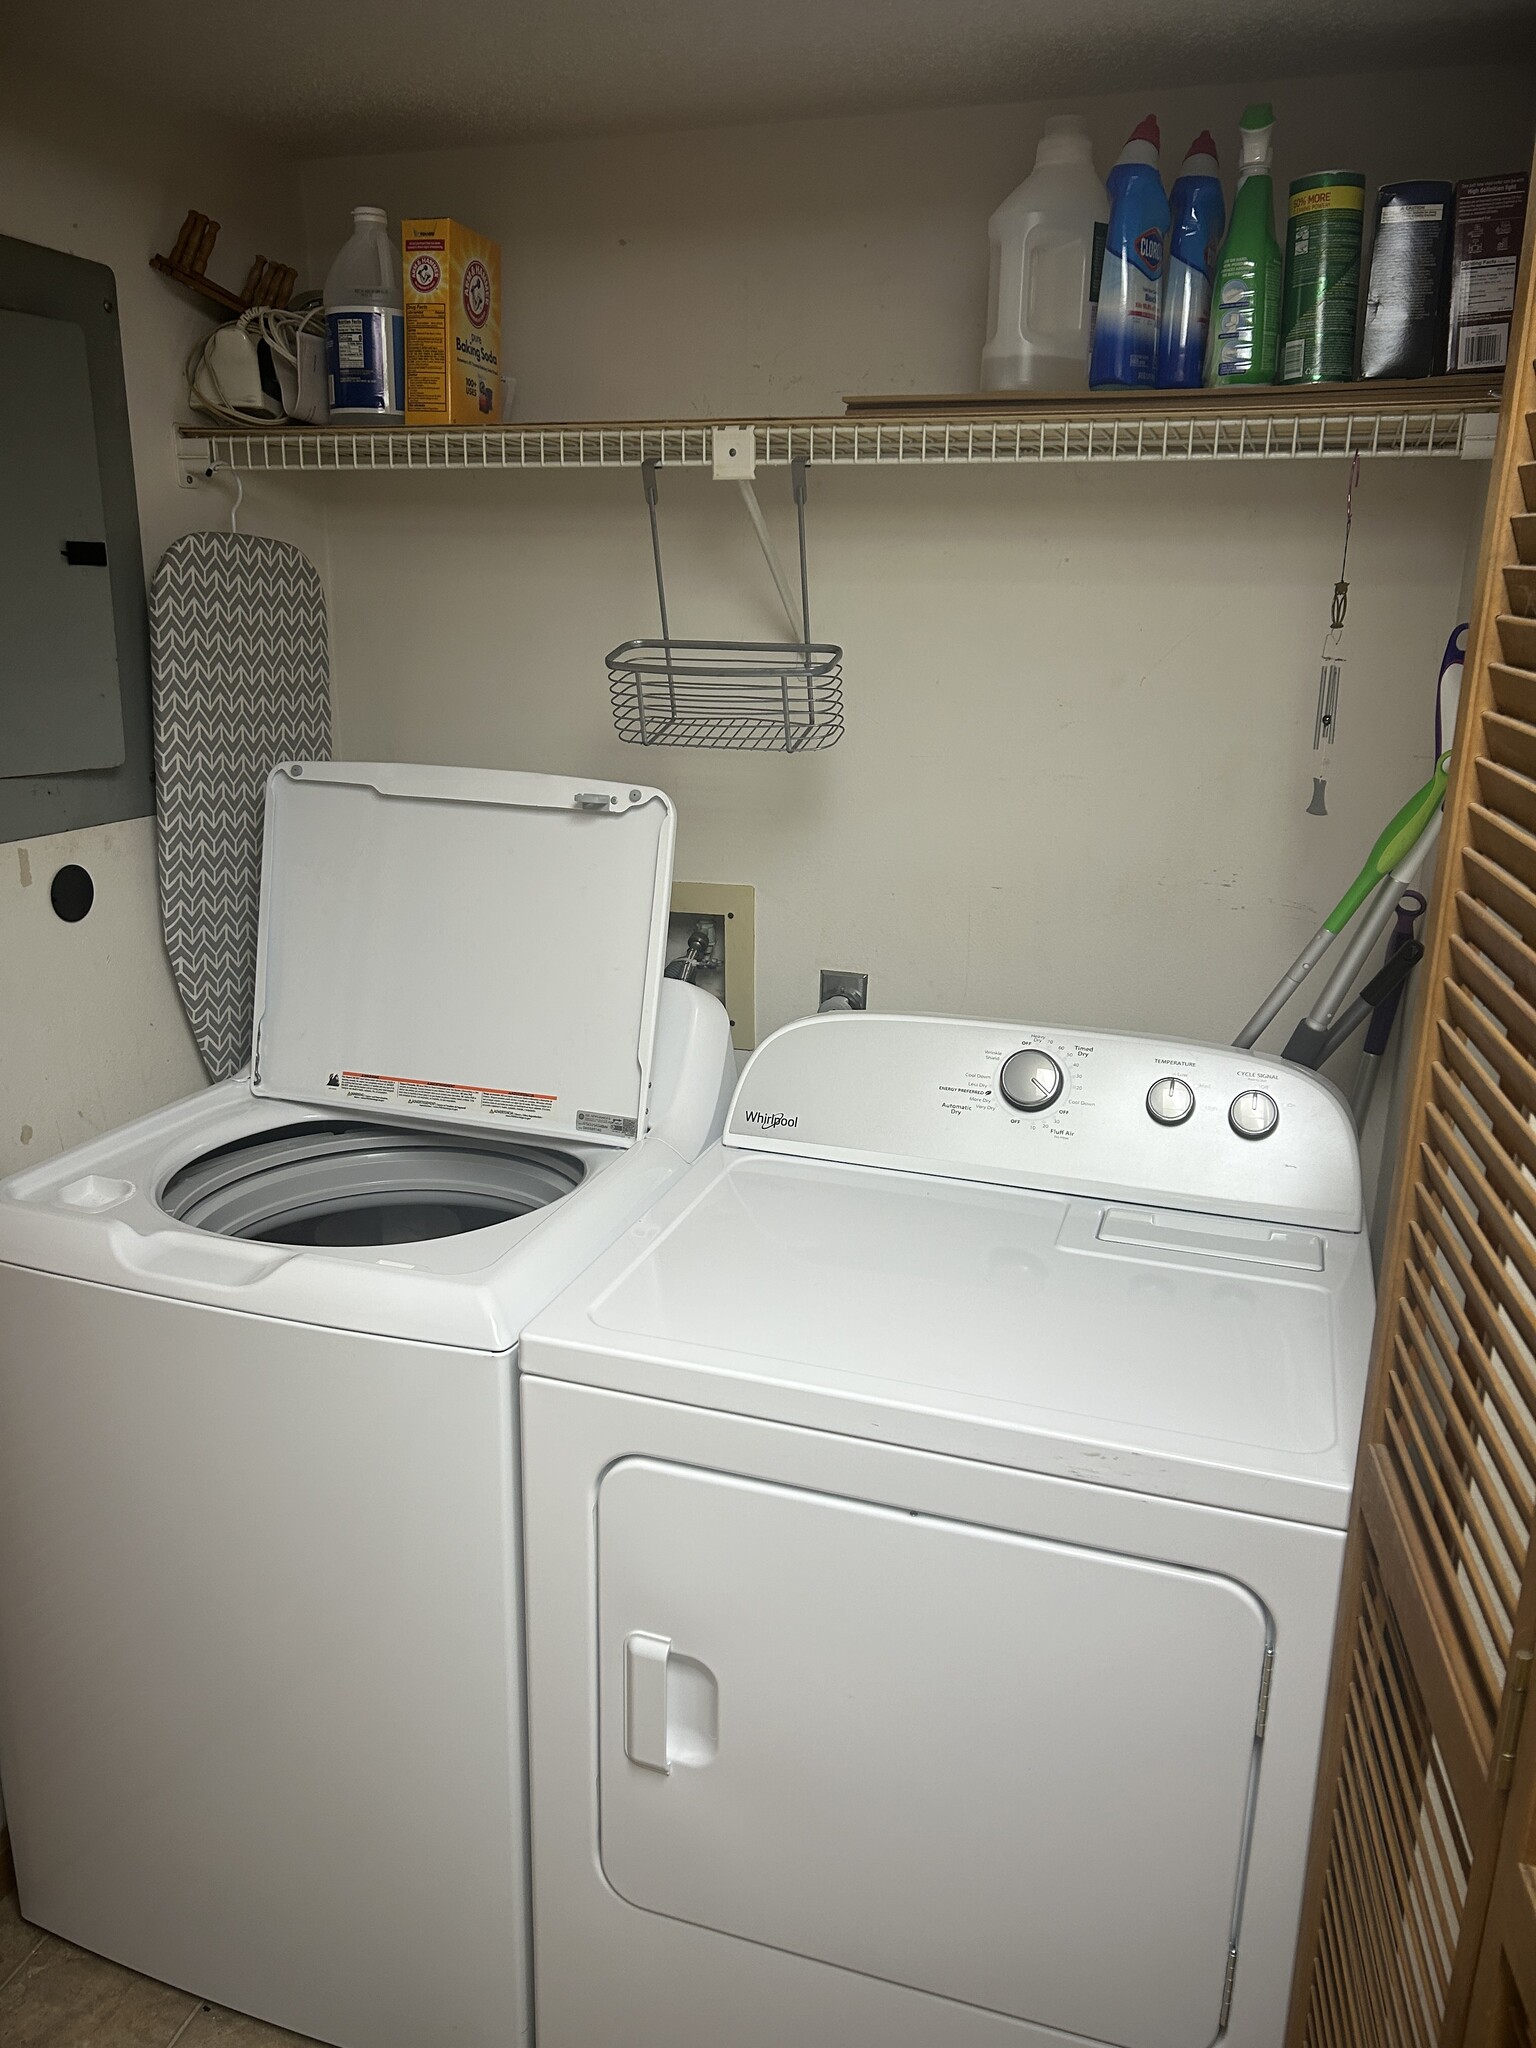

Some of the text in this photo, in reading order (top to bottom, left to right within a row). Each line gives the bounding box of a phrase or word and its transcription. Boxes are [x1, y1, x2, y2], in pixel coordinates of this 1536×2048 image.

[1308, 192, 1331, 204] MORE
[470, 334, 482, 344] pure
[456, 336, 498, 365] Baking Soda
[466, 378, 476, 388] 100+
[466, 387, 476, 397] USES
[1154, 1058, 1196, 1068] TEMPERATURE
[1256, 1072, 1279, 1080] SIGNAL
[942, 1102, 972, 1111] Automatic
[745, 1110, 798, 1130] Whirlpool
